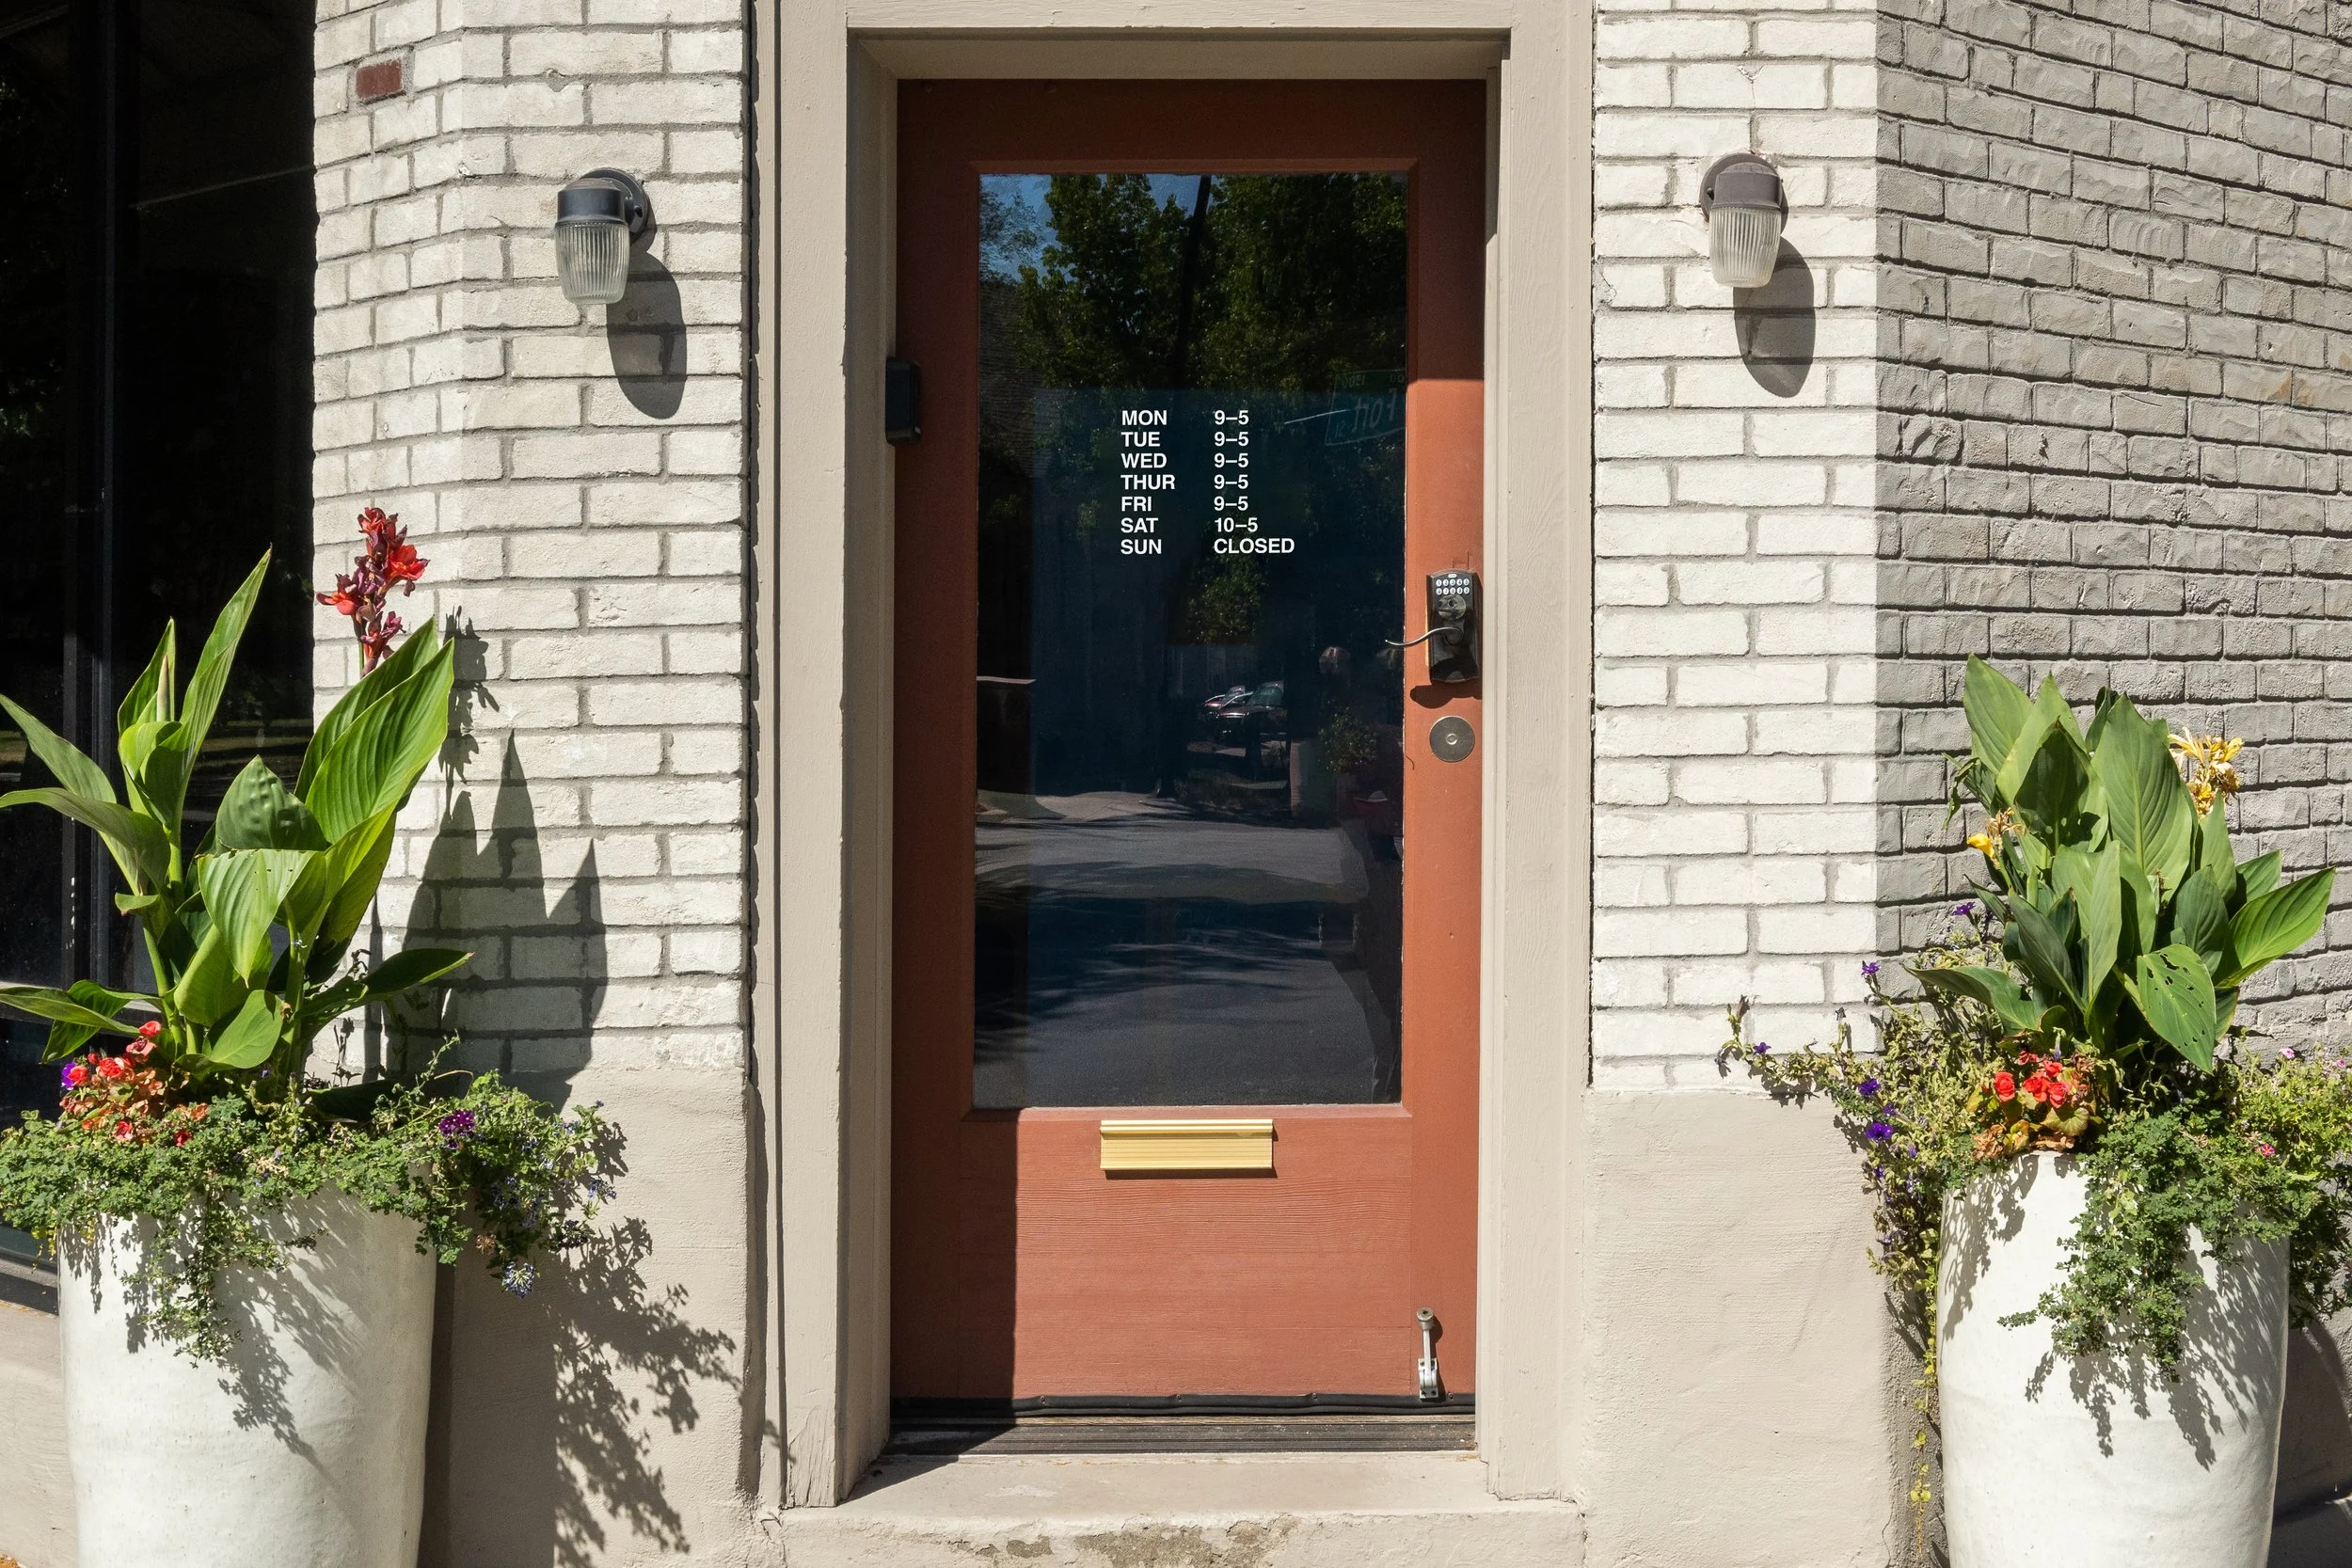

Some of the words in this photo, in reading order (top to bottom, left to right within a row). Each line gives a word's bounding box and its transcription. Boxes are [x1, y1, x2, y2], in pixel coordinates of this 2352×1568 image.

[1121, 410, 1168, 426] MON
[1121, 432, 1161, 447] TUE
[1121, 453, 1168, 468] WED
[1120, 474, 1176, 490] THUR
[1121, 496, 1152, 512] FRI
[1120, 517, 1159, 533] SAT
[1120, 539, 1162, 555] SUN
[1214, 538, 1295, 554] CLOSED
